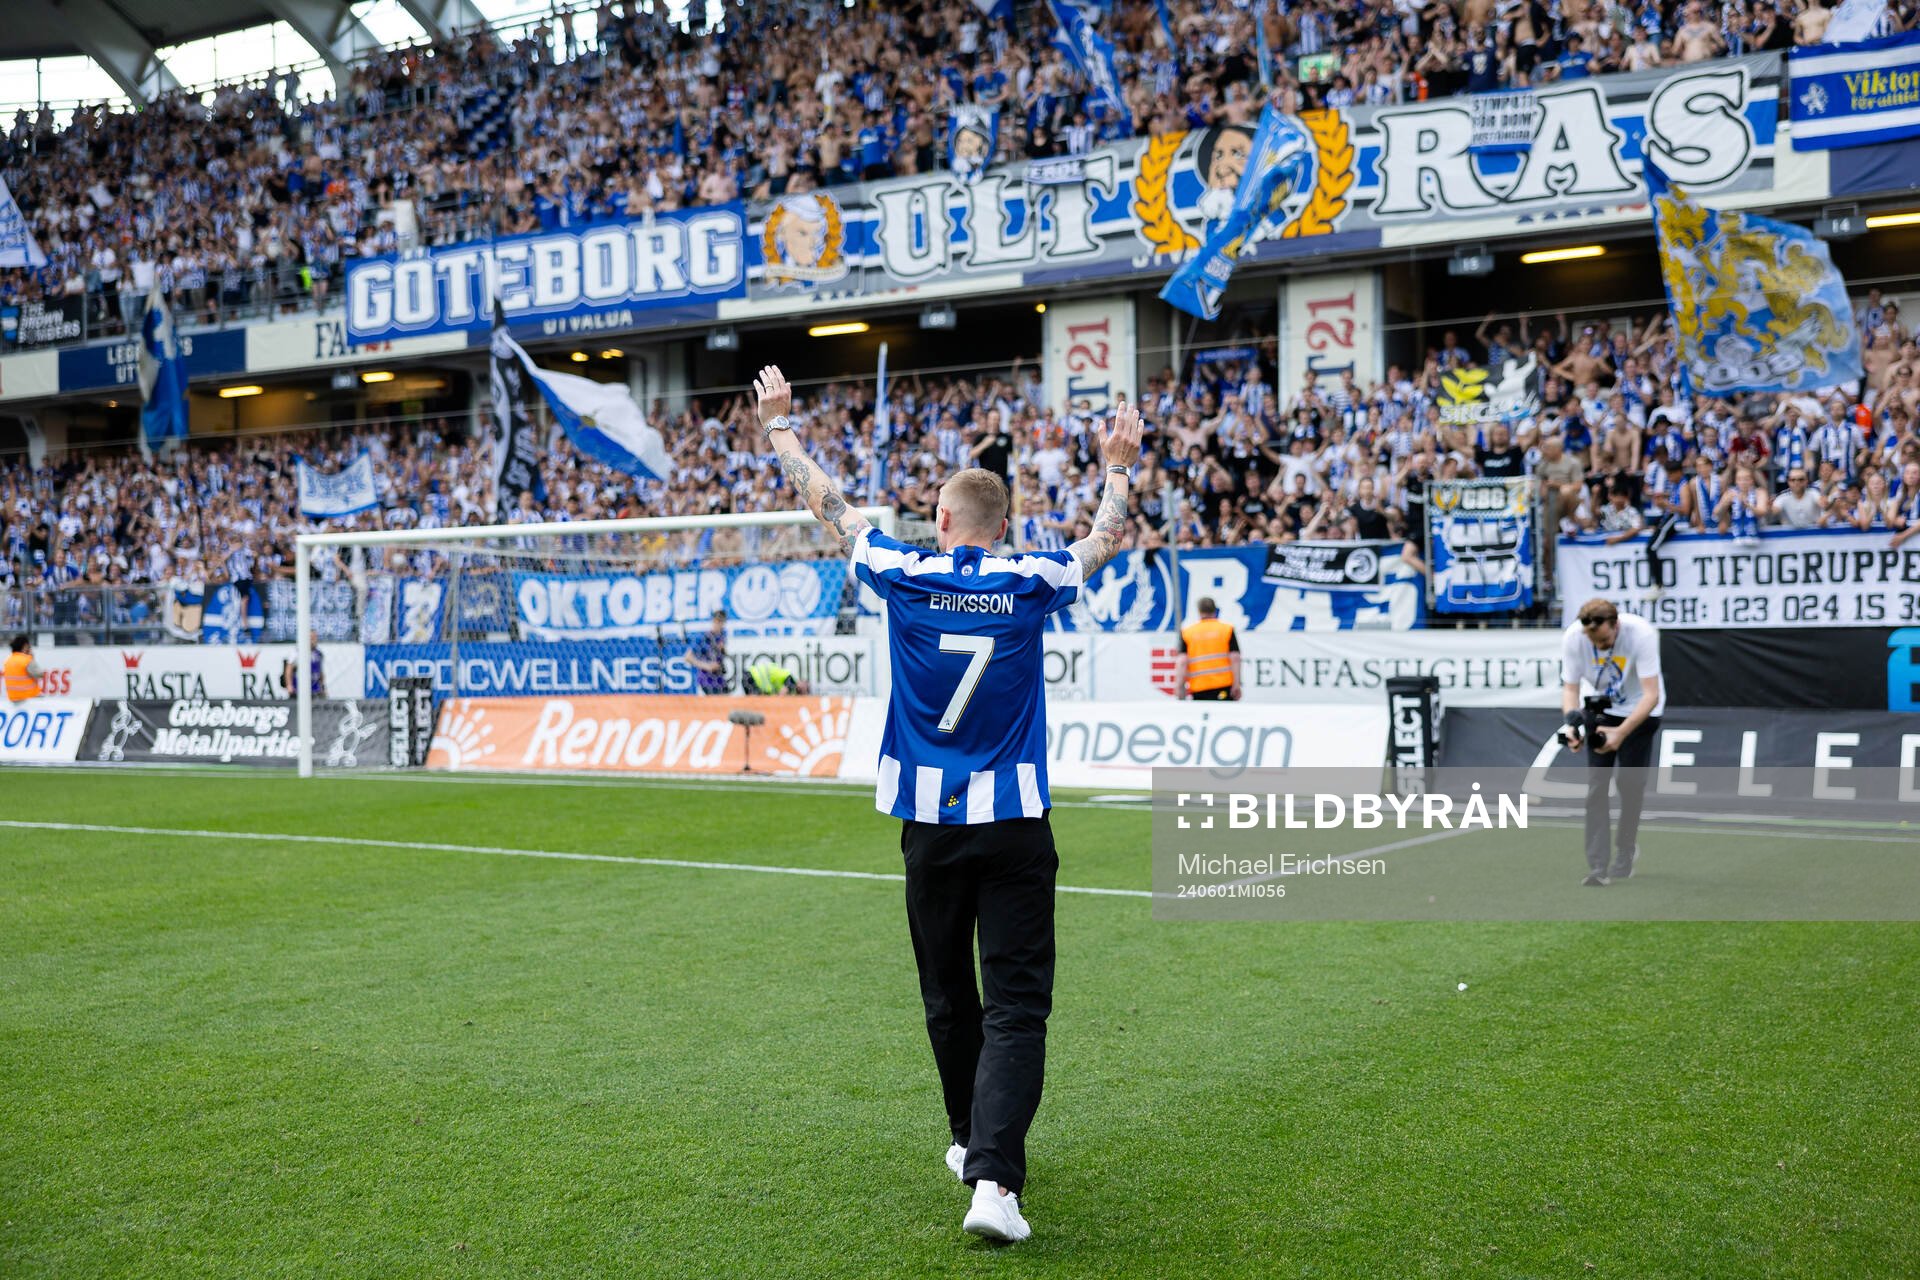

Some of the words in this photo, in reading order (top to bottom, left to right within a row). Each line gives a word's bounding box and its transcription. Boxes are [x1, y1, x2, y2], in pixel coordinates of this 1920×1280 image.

[351, 213, 742, 333] GÖTEBORG
[518, 570, 727, 627] OKTOBER
[929, 593, 1014, 615] ERIKSSON
[1614, 597, 1708, 624] WISH:
[1722, 596, 1769, 621] 123
[1783, 594, 1839, 621] 024
[1855, 593, 1886, 620] 15
[126, 672, 208, 700] RASTA
[937, 633, 995, 733] 7
[168, 699, 290, 734] Göteborgs
[523, 699, 733, 769] Renova
[151, 728, 316, 763] Metallpartie
